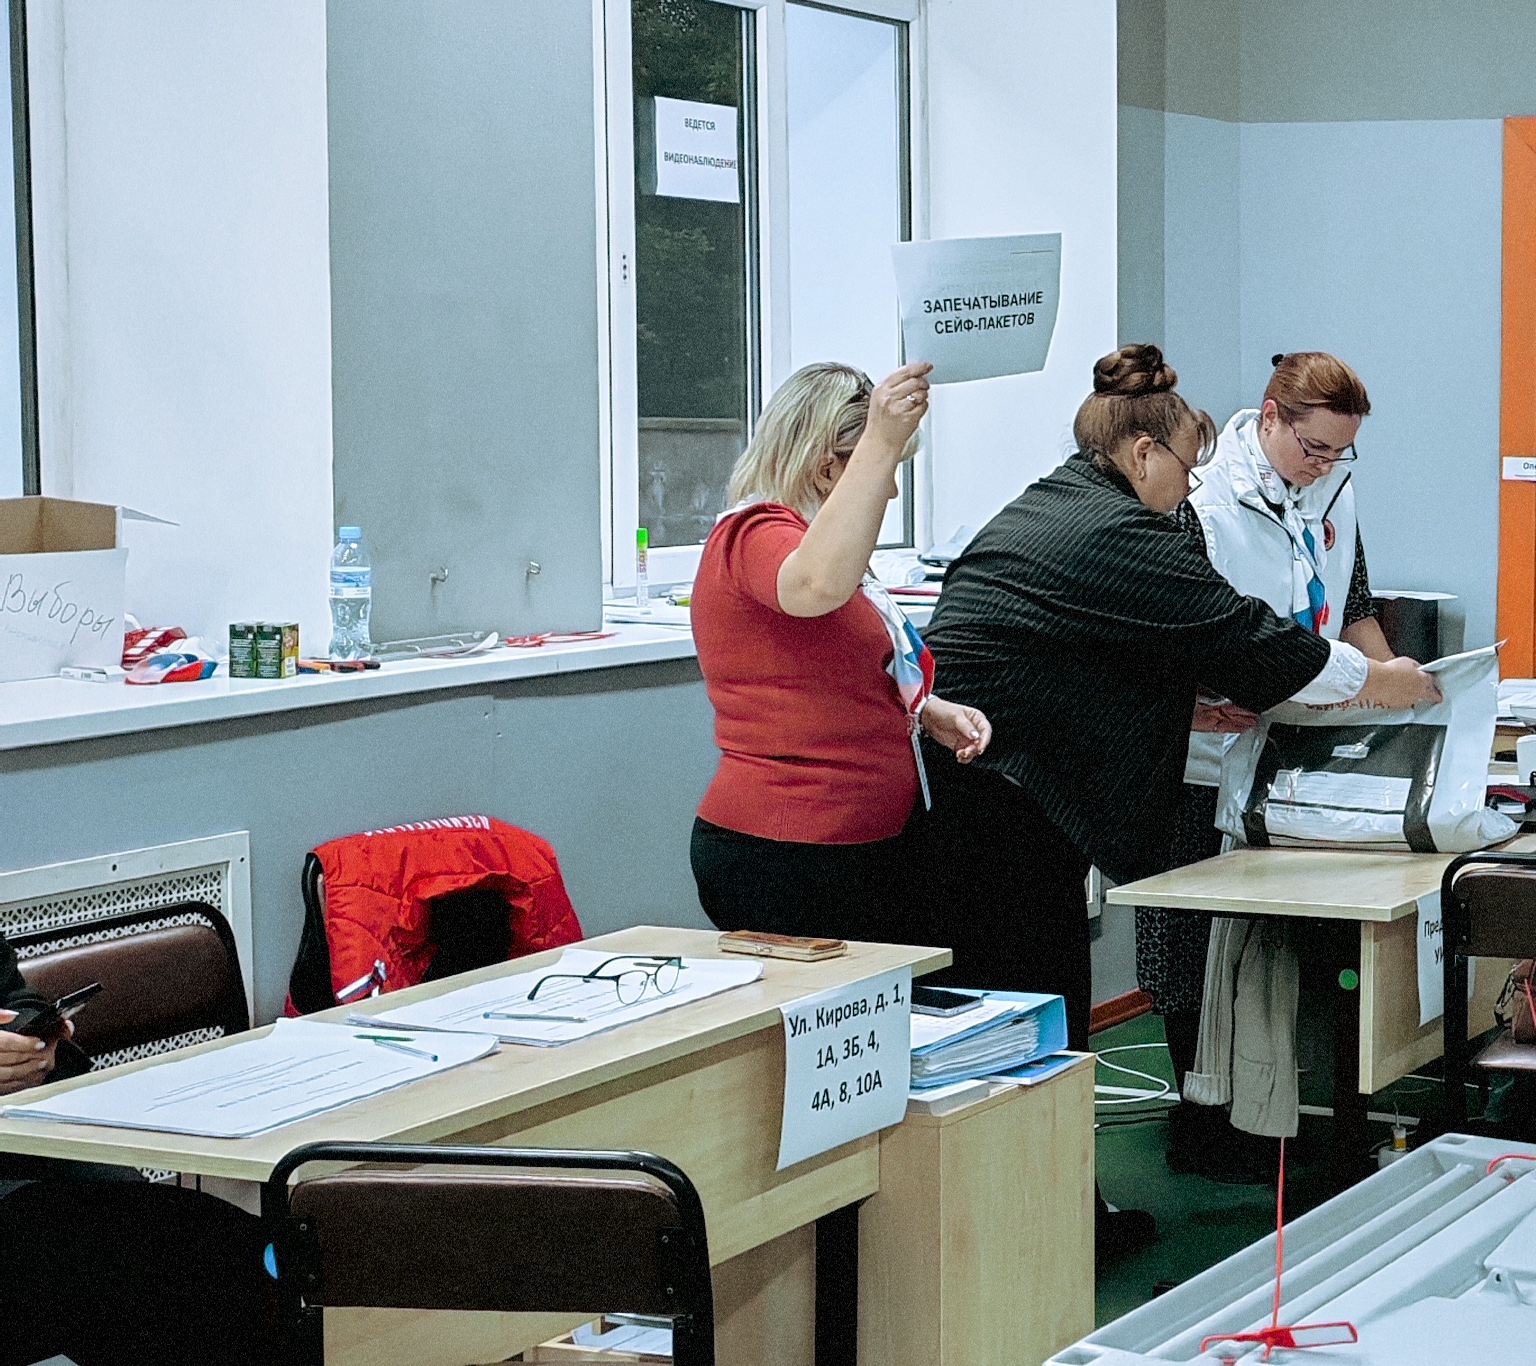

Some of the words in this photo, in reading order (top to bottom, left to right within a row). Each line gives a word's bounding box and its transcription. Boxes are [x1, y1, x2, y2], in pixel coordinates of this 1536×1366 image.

[684, 118, 716, 131] ВЕДЕТСЯ
[663, 151, 737, 169] ВИДЕОНАБЛЮДЕНИЕ
[923, 291, 1044, 314] ЗАПЕЧАТЫВАНИЕ
[934, 312, 1035, 335] СЕЙФ-ПАКЕТОВ
[0, 573, 115, 645] Выборы
[788, 1015, 812, 1038] Ул.
[816, 998, 872, 1029] Кирова,
[875, 992, 888, 1014] д.
[893, 983, 905, 1005] 1,
[816, 1045, 838, 1069] 1А,
[842, 1035, 864, 1058] 3Б,
[867, 1030, 880, 1052] 4,
[811, 1088, 835, 1112] 4А,
[839, 1081, 852, 1104] 8,
[856, 1069, 883, 1096] 10А
